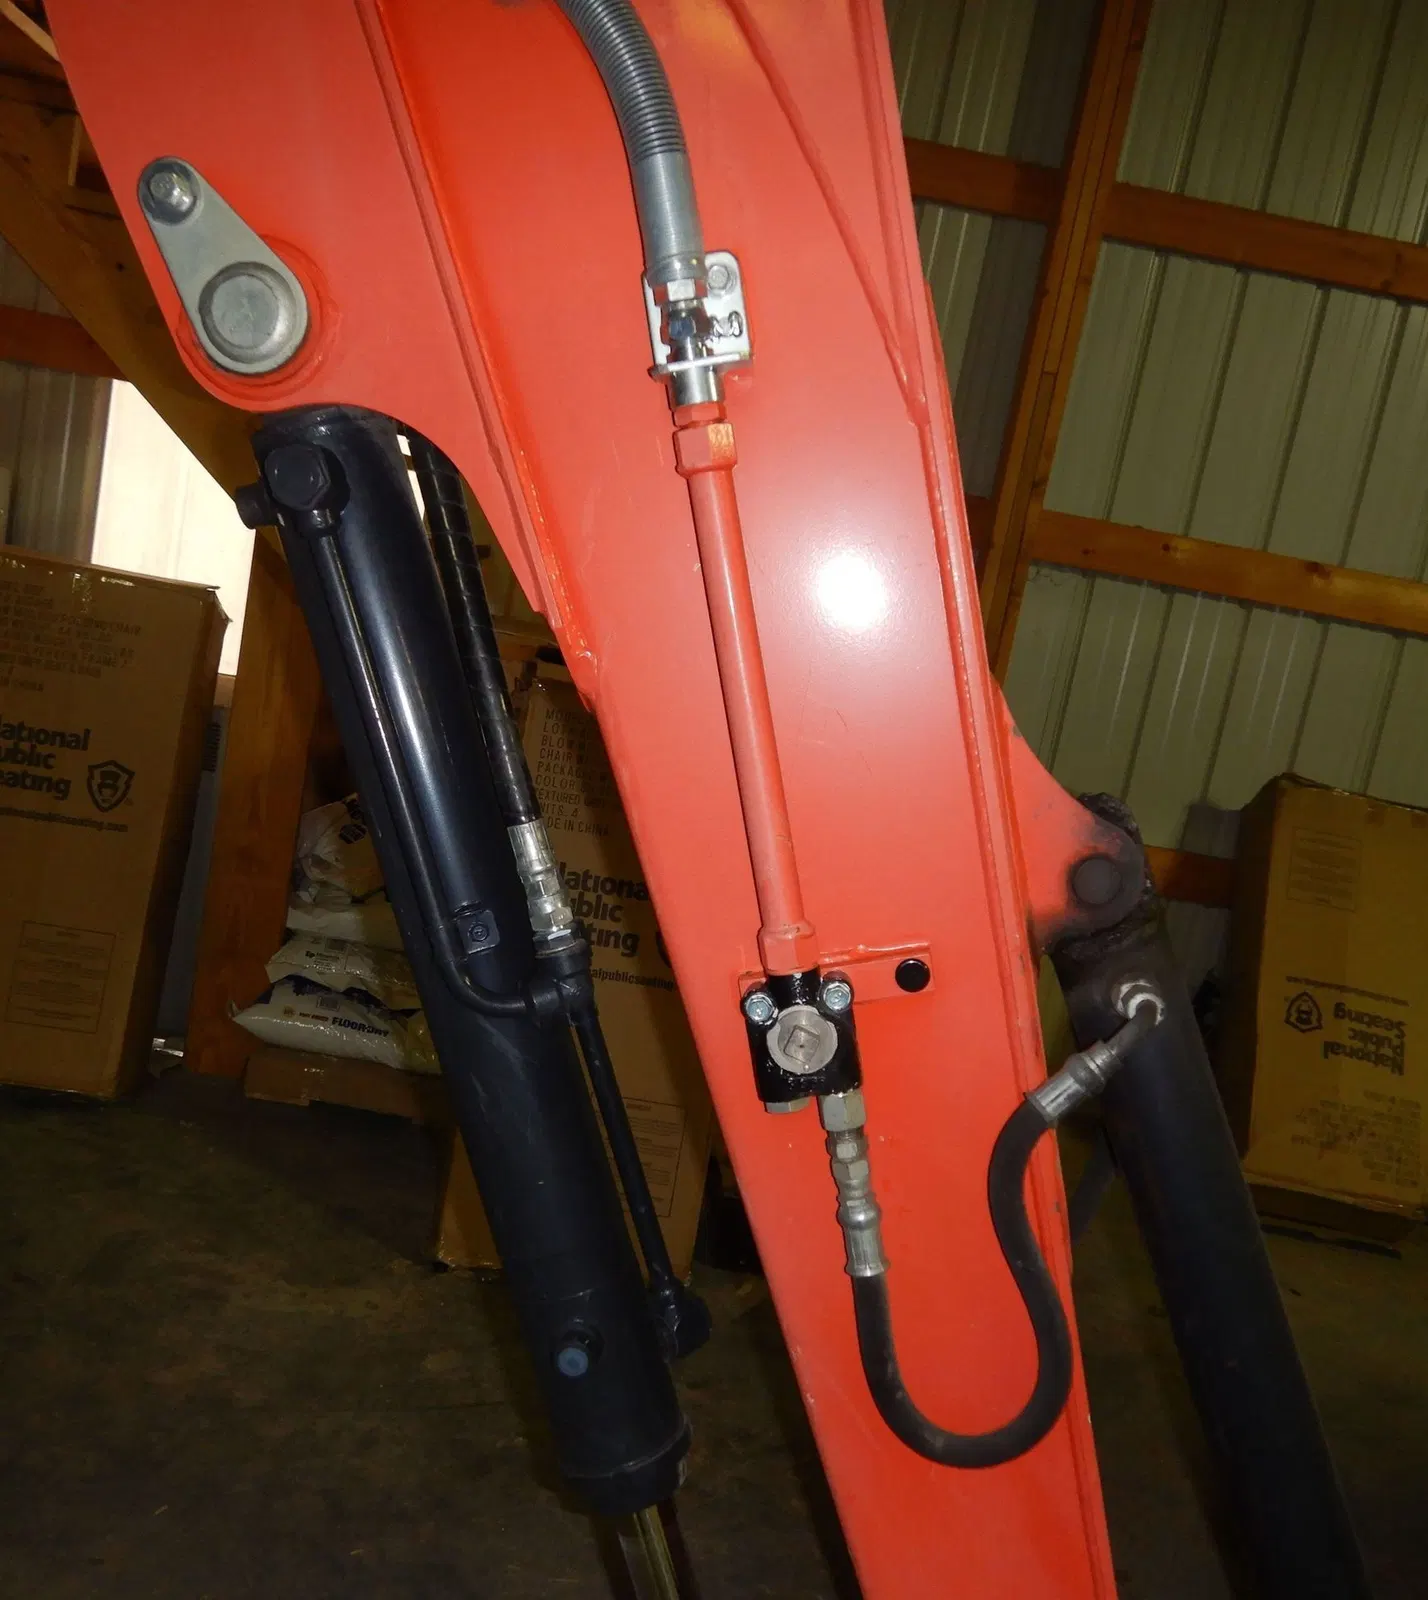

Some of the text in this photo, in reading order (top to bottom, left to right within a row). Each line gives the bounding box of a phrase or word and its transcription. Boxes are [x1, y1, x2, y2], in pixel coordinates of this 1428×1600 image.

[0, 713, 92, 751] ational
[0, 741, 56, 770] ublic
[540, 748, 573, 762] CHAIR
[0, 769, 72, 800] ating
[536, 788, 580, 805] EXTURED
[547, 817, 609, 836] DE IN CHINA
[559, 861, 649, 901] ationa
[570, 891, 624, 923] blic
[584, 921, 640, 957] ting
[1333, 1002, 1408, 1038] Seating
[1323, 1041, 1405, 1077] National
[1347, 1027, 1405, 1059] Public
